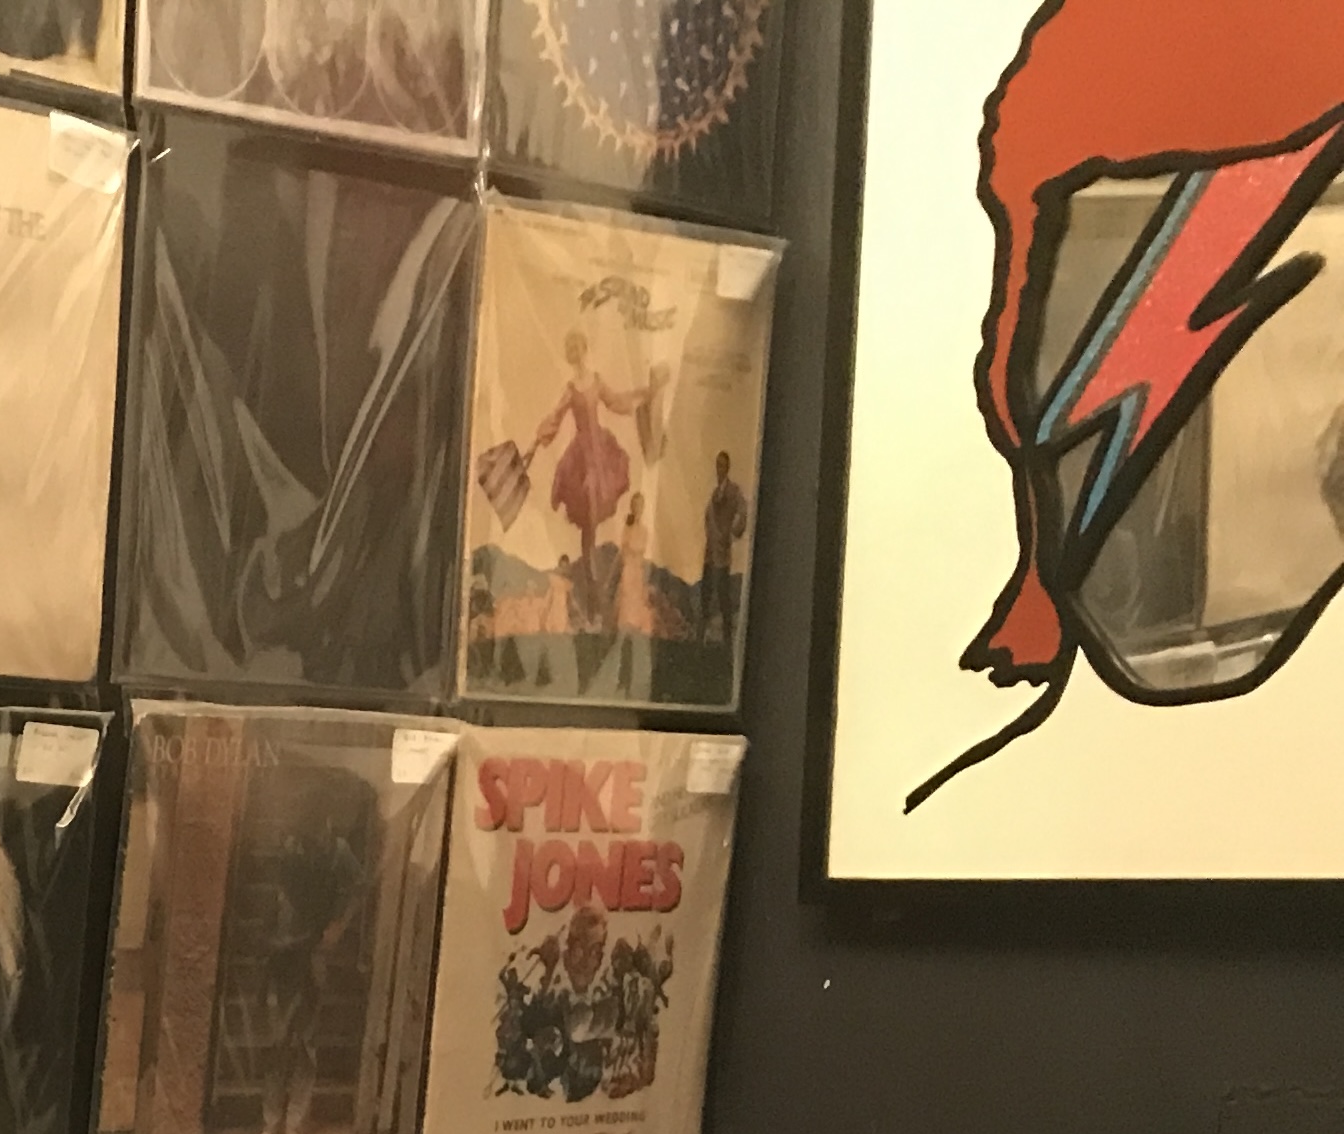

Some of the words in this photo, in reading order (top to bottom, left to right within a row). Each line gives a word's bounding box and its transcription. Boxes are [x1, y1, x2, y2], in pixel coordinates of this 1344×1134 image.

[4, 206, 48, 241] THE
[151, 734, 197, 766] BOB
[473, 757, 649, 833] SPIKE
[501, 839, 686, 936] JONES
[502, 1117, 536, 1132] WENT
[539, 1116, 556, 1129] TO
[560, 1114, 591, 1128] YOUR
